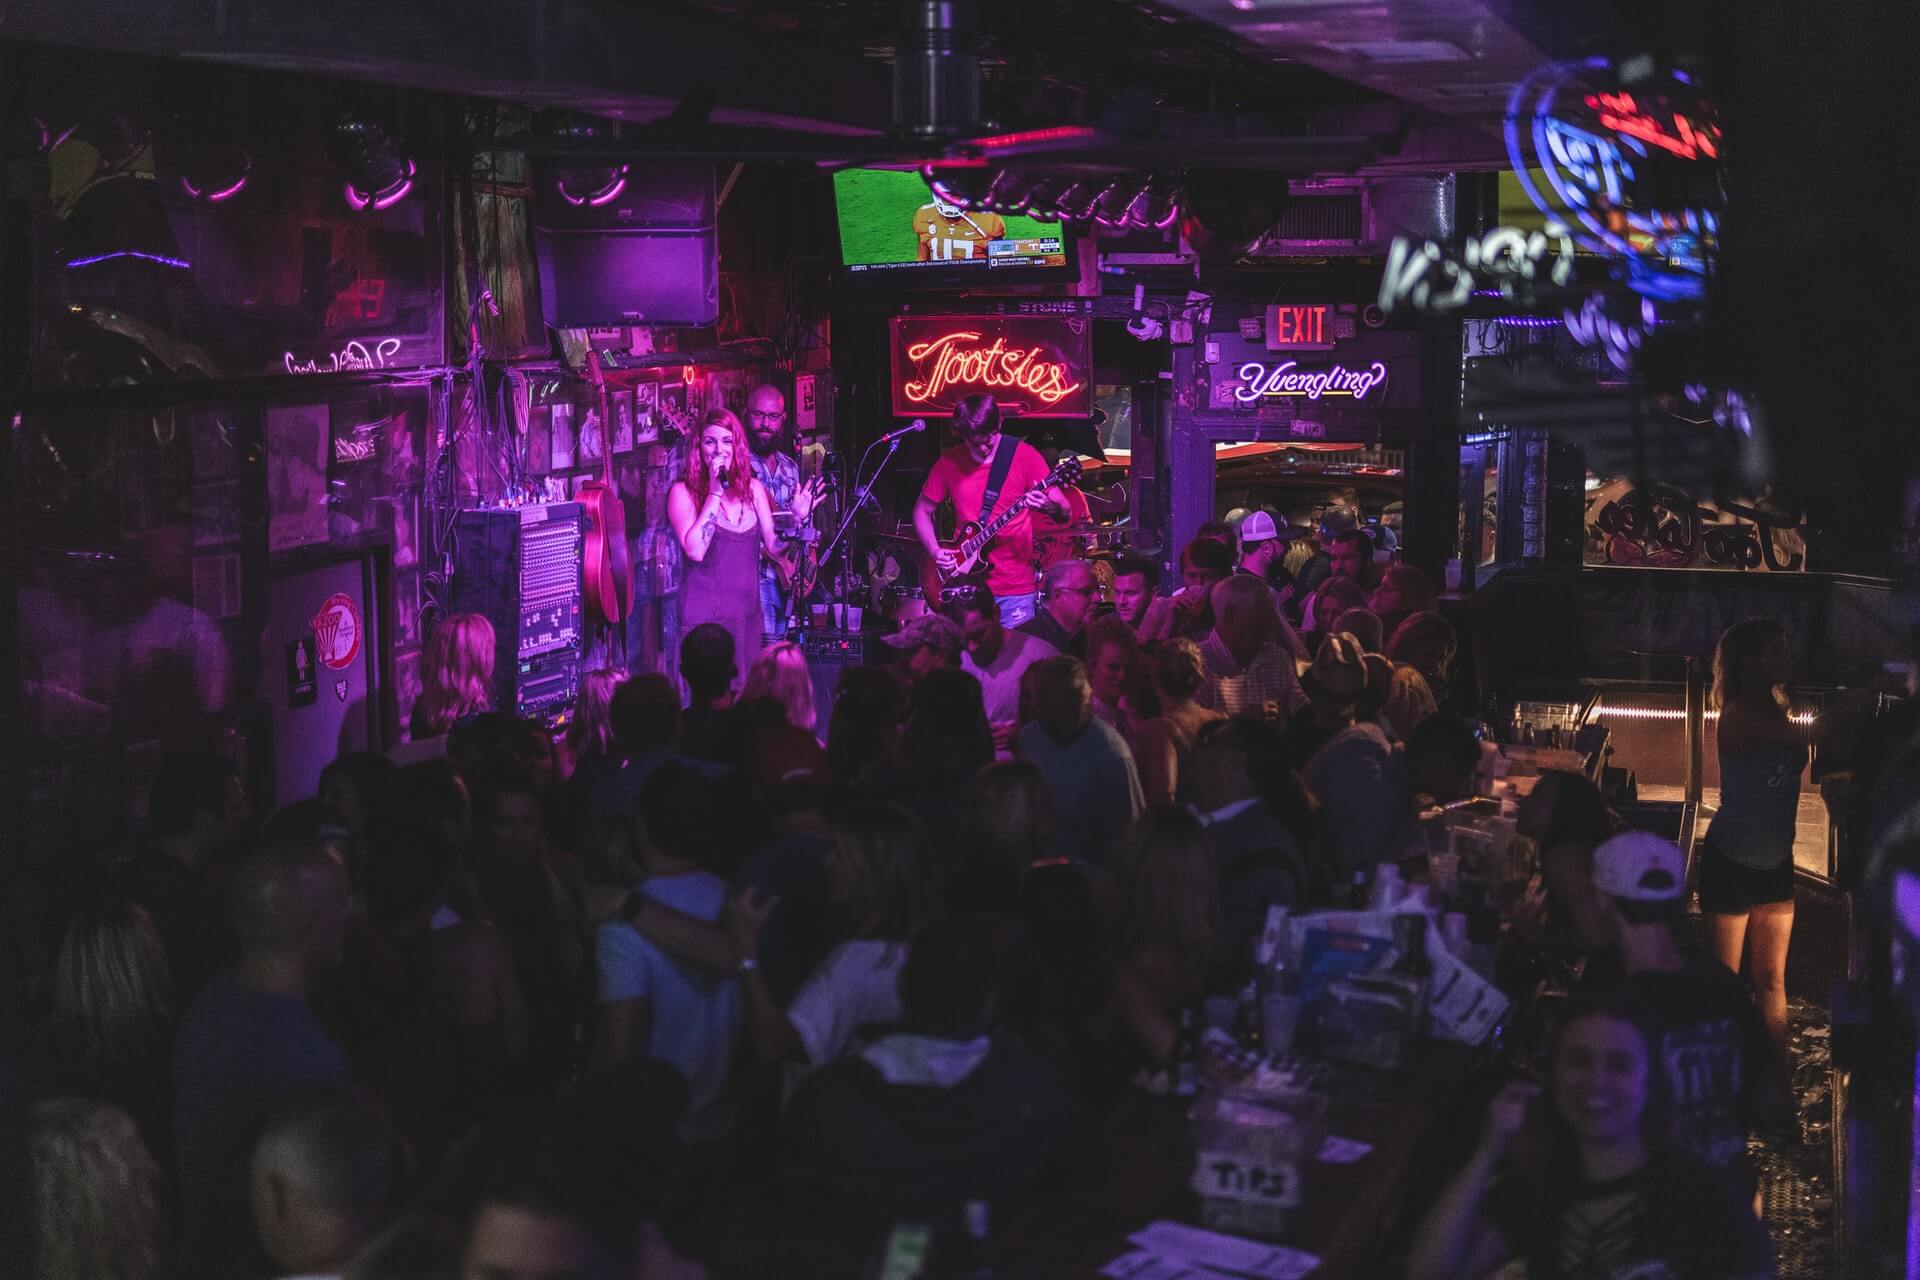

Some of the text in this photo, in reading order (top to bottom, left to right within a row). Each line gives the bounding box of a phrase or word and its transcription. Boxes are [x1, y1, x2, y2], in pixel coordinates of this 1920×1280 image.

[1279, 306, 1326, 343] EXIT
[905, 332, 1080, 401] Tootsies
[1235, 361, 1386, 401] Yuengling
